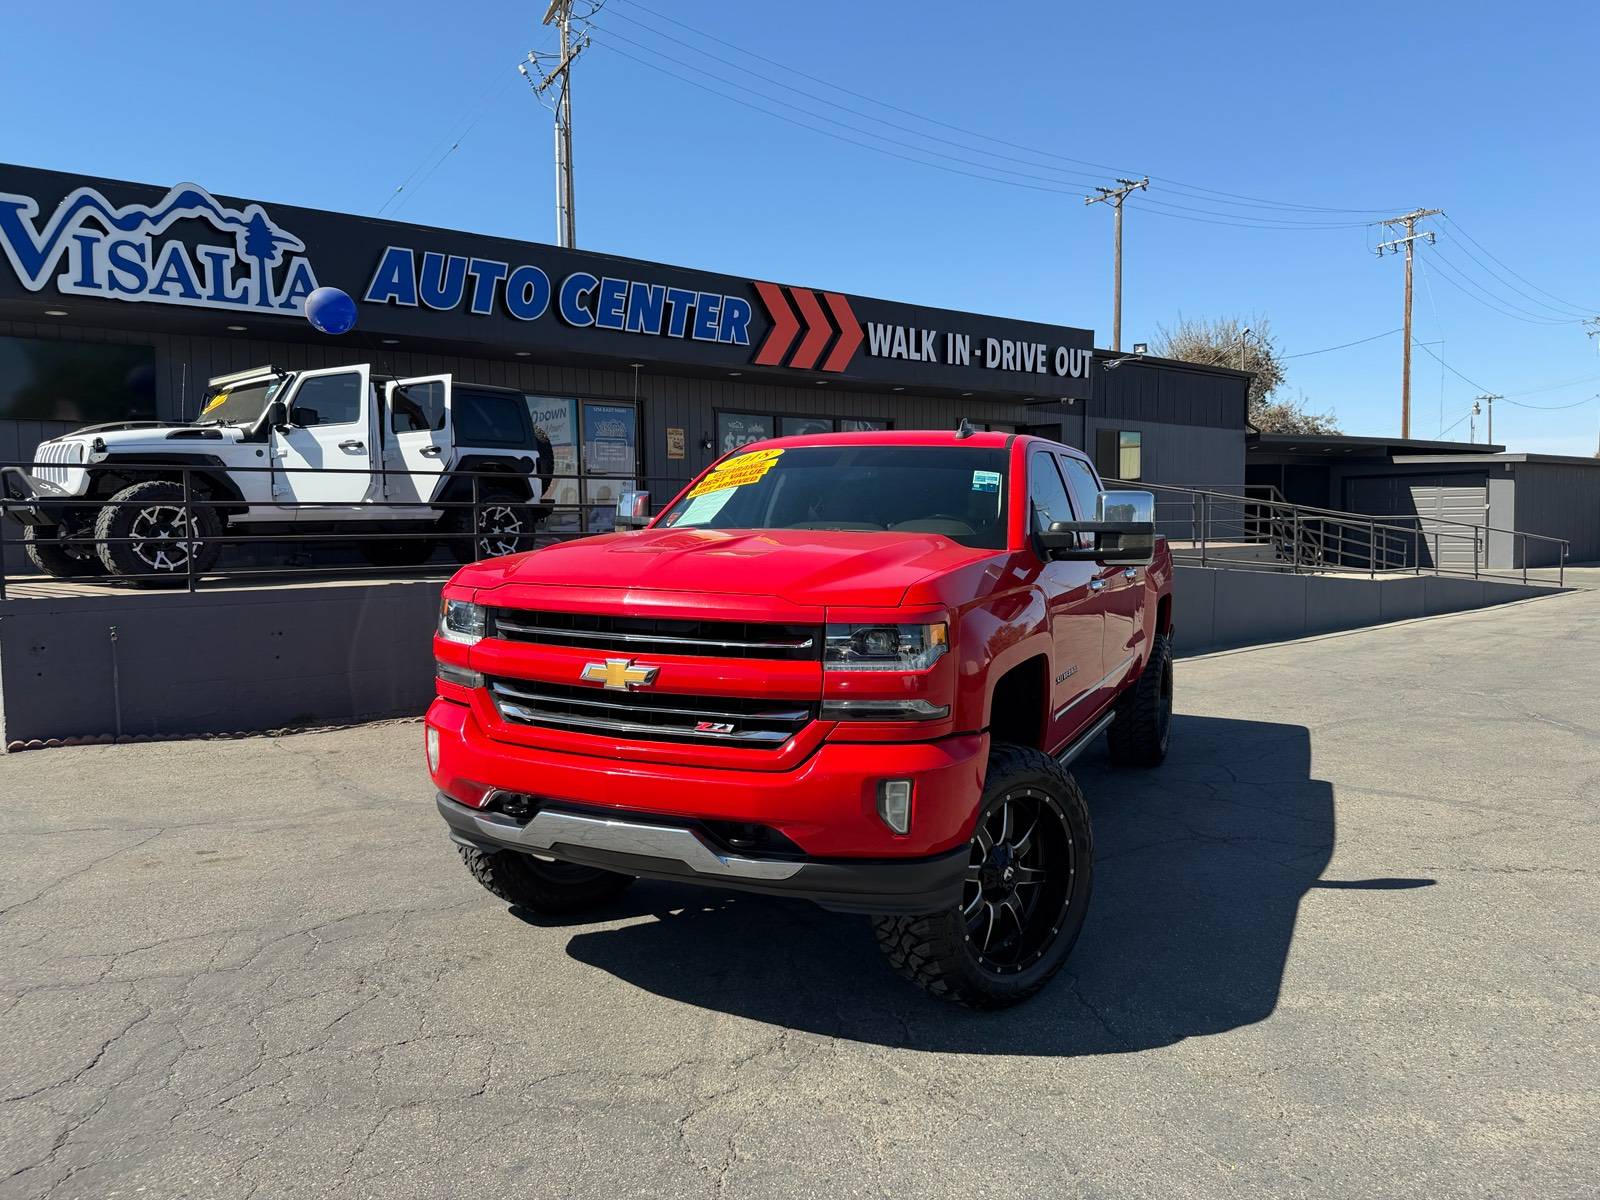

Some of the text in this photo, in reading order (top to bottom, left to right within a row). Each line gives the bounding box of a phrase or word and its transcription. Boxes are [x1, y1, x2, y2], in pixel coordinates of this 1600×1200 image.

[0, 193, 320, 314] VISALIA
[365, 246, 752, 345] AUTO CENTER
[868, 322, 937, 362] WALK
[947, 332, 970, 366] IN
[986, 337, 1047, 374] DRIVE
[1055, 346, 1093, 379] OUT
[539, 408, 567, 421] DOWN
[698, 467, 765, 487] BEST VALUE
[718, 475, 759, 489] ARRIVED
[695, 721, 735, 733] Z71
